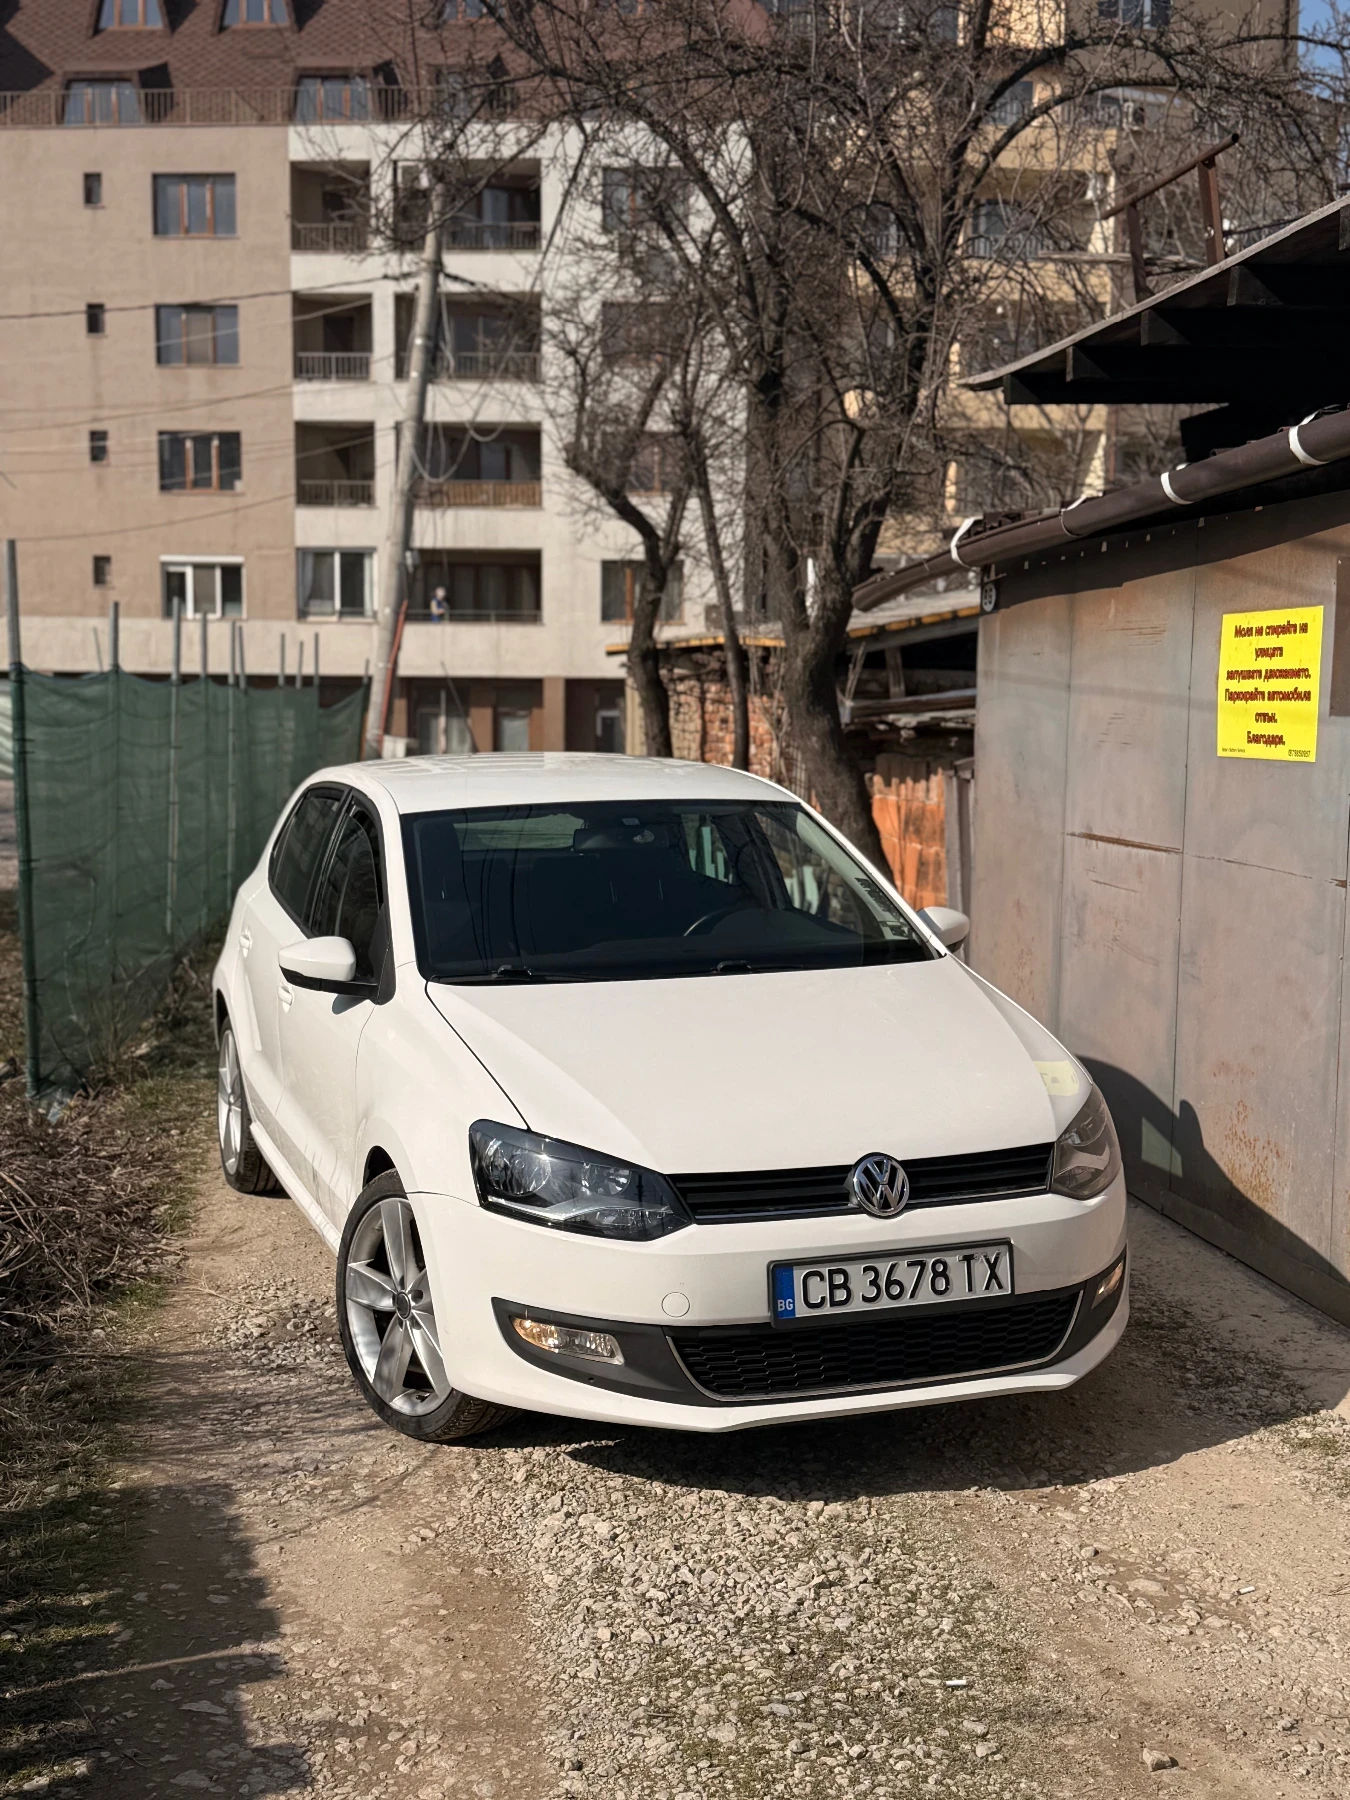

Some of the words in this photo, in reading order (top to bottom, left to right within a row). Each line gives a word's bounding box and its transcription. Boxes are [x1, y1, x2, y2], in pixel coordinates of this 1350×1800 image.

[1234, 625, 1253, 638] Моля
[1255, 626, 1263, 636] не
[1265, 620, 1297, 638] спирайте
[1299, 622, 1308, 634] на
[1255, 646, 1283, 661] улицата
[1225, 687, 1265, 704] Паркирайте
[1255, 712, 1277, 723] отвън.
[801, 1267, 850, 1309] CB
[860, 1257, 950, 1304] 3678
[957, 1251, 1004, 1293] TX
[777, 1298, 794, 1311] BG
